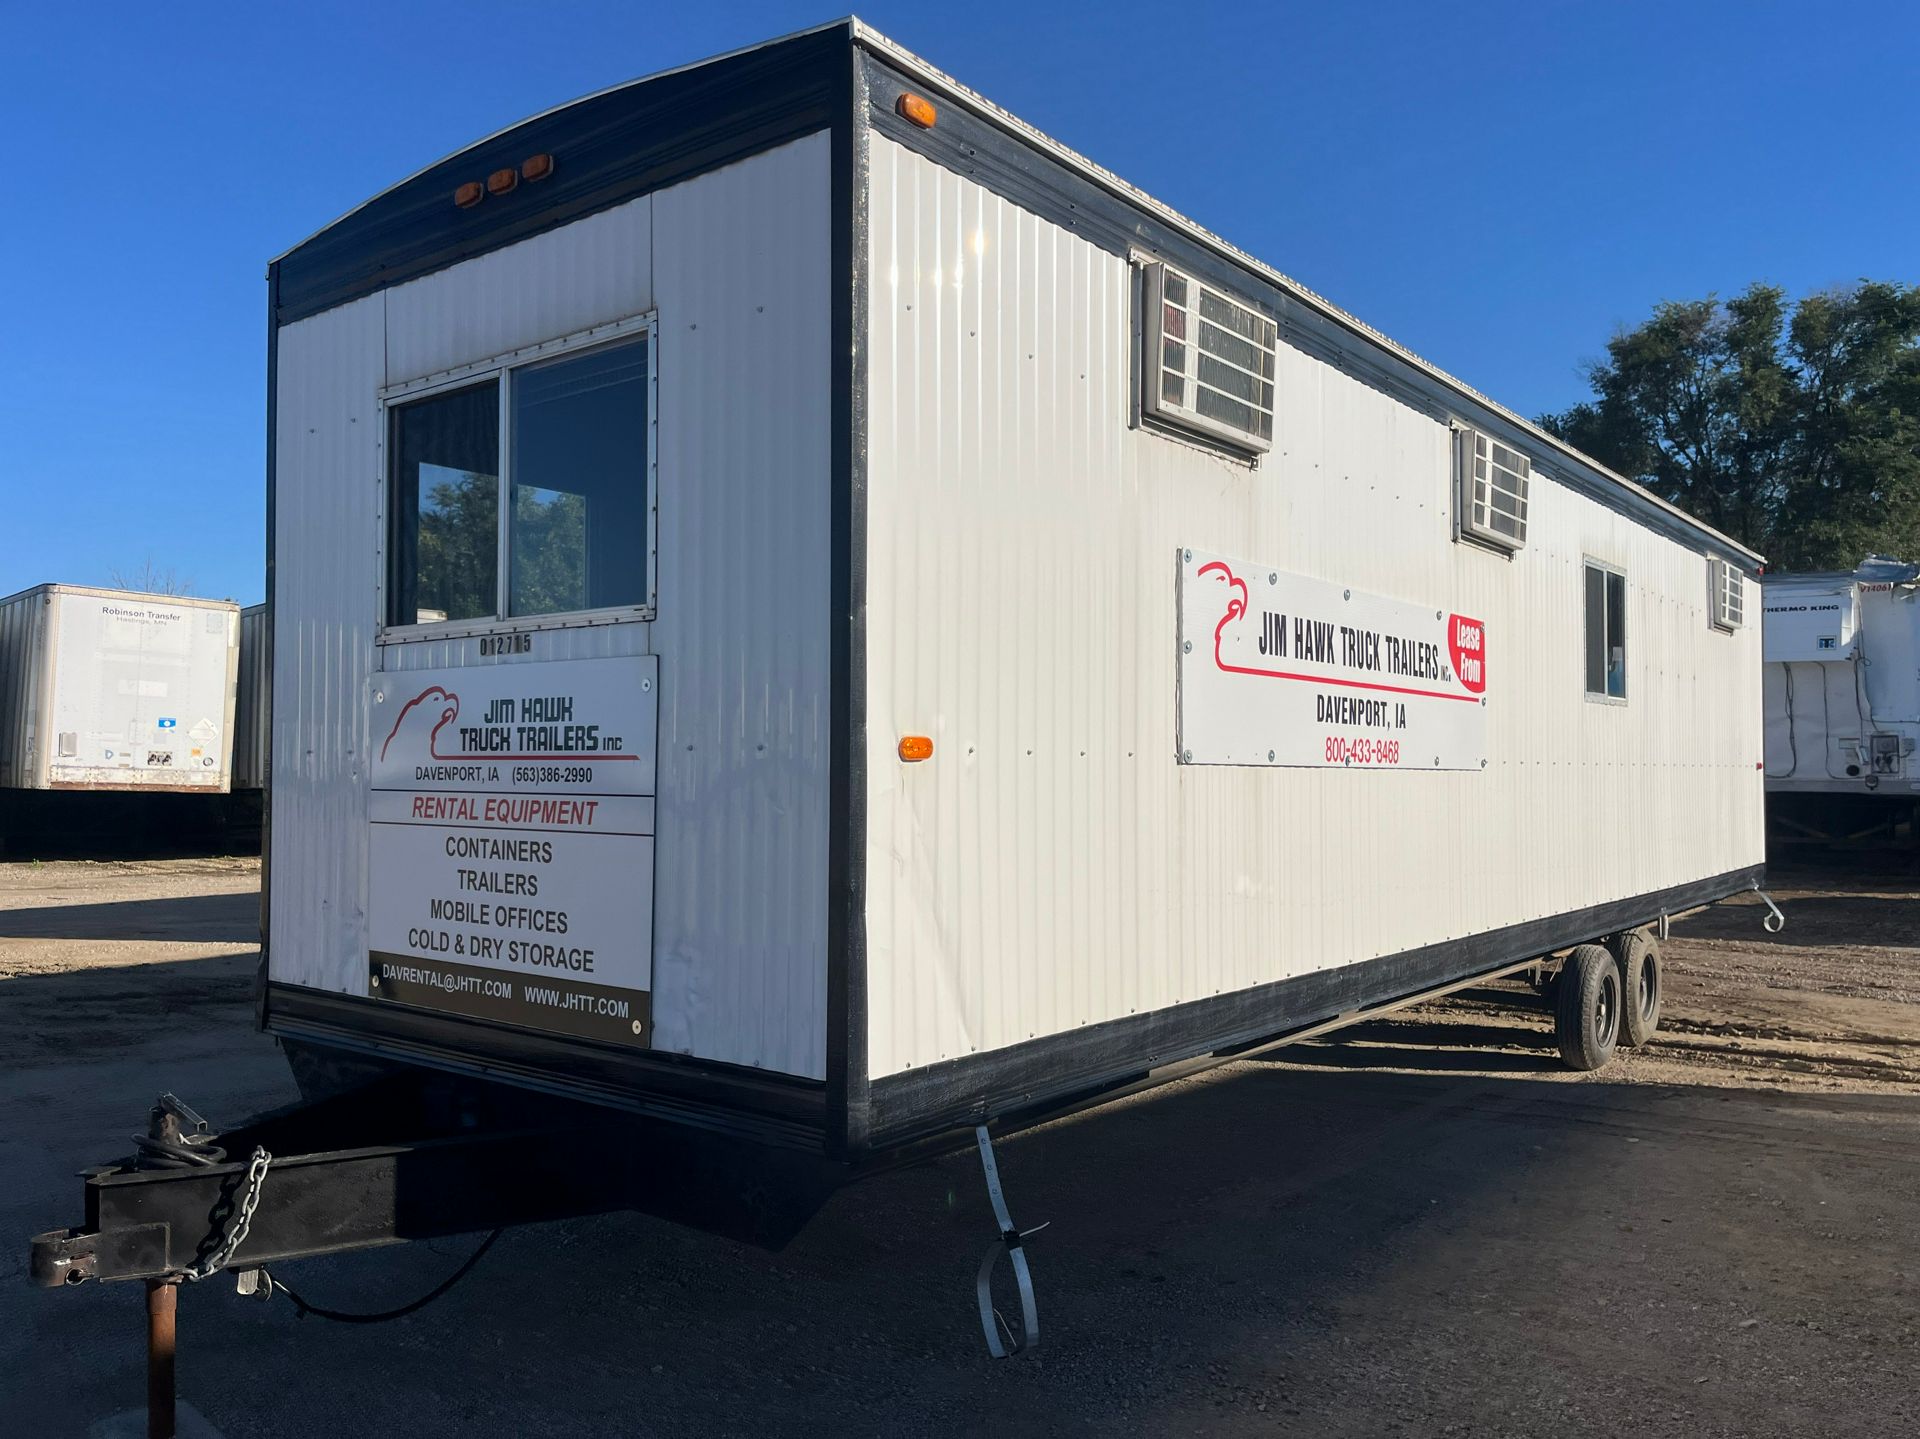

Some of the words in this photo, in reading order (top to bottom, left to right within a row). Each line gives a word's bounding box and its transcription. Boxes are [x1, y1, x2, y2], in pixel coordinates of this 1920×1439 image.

[102, 606, 145, 618] Robinson
[147, 611, 181, 621] Transfer
[480, 634, 531, 656] 012715
[1258, 611, 1287, 657] JIM
[1294, 617, 1335, 664] HAWK
[1340, 626, 1381, 671] TRUCK
[1385, 635, 1439, 681] TRAILERS
[1456, 619, 1480, 651] Lease
[1460, 652, 1480, 683] From
[484, 699, 515, 724] JIM
[522, 696, 573, 722] HAWK
[1316, 694, 1390, 732] DAVENPORT,
[1395, 703, 1406, 729] IA
[460, 727, 510, 752] TRUCK
[517, 725, 599, 751] TRAILERS
[1325, 736, 1400, 765] 800-433-8468
[415, 766, 485, 784] DAVENPORT,
[488, 767, 499, 782] IA
[512, 767, 593, 786] (563)386-2990
[412, 797, 479, 820] RENTAL
[485, 799, 598, 825] EQUIPMENT
[446, 836, 552, 863] CONTAINERS
[457, 869, 538, 896] TRAILERS
[431, 899, 490, 925] MOBILE
[495, 905, 568, 934] OFFICES
[408, 928, 449, 952] COLD
[455, 935, 465, 955] &
[470, 936, 504, 960] DRY
[508, 941, 594, 973] STORAGE
[382, 964, 512, 999] DAVRENTAL@JHTT.COM
[524, 986, 629, 1018] WWW.JHTT.COM
